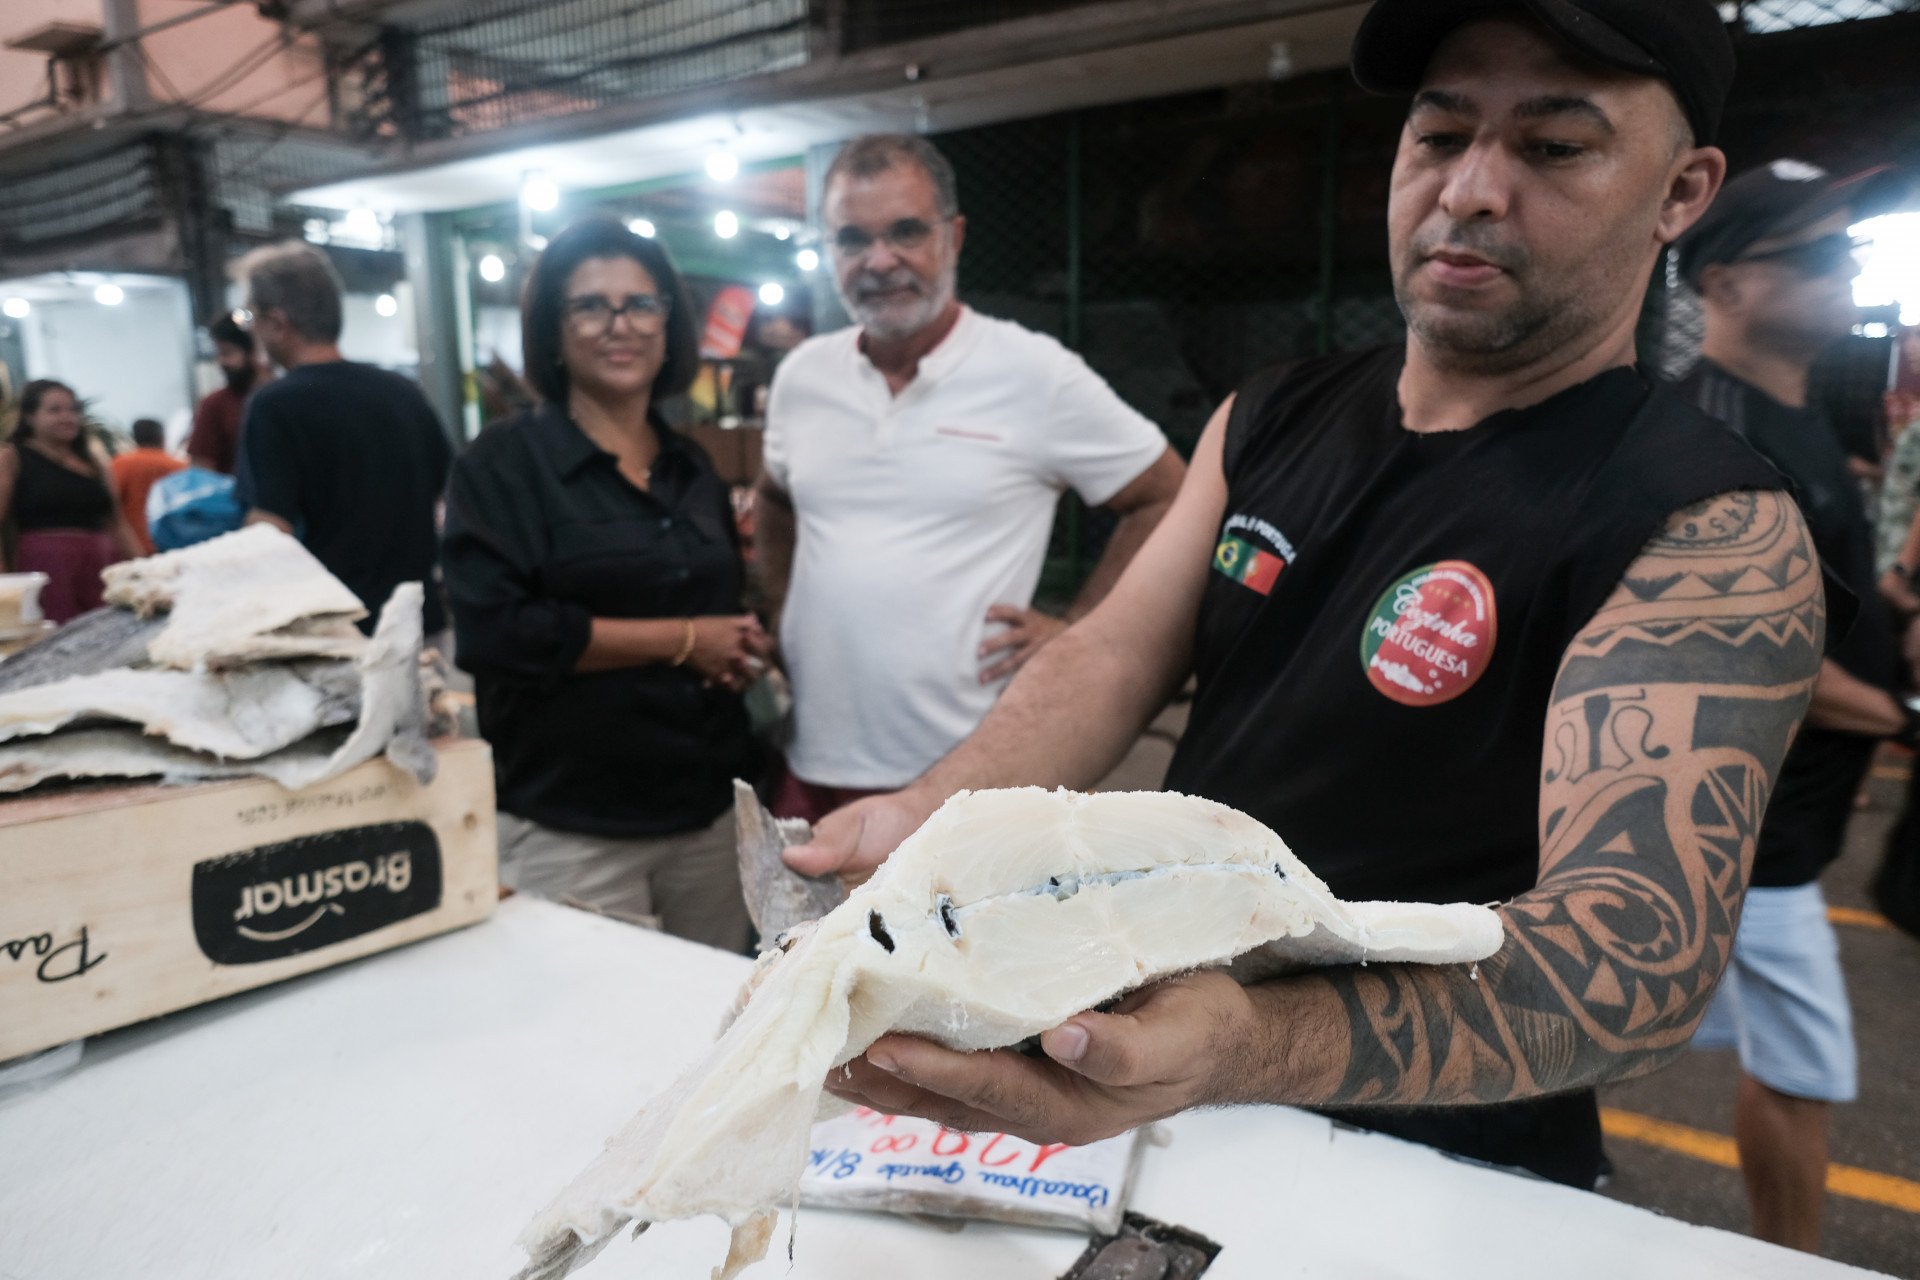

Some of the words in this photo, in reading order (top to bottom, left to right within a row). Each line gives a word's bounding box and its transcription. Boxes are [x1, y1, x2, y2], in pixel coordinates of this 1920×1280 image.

[1254, 519, 1297, 565] PORTUGA
[1370, 616, 1468, 678] PORTUGUESA
[1393, 584, 1478, 648] Cozinha
[233, 851, 411, 923] Brasmar
[977, 1171, 1109, 1208] Bacalhau
